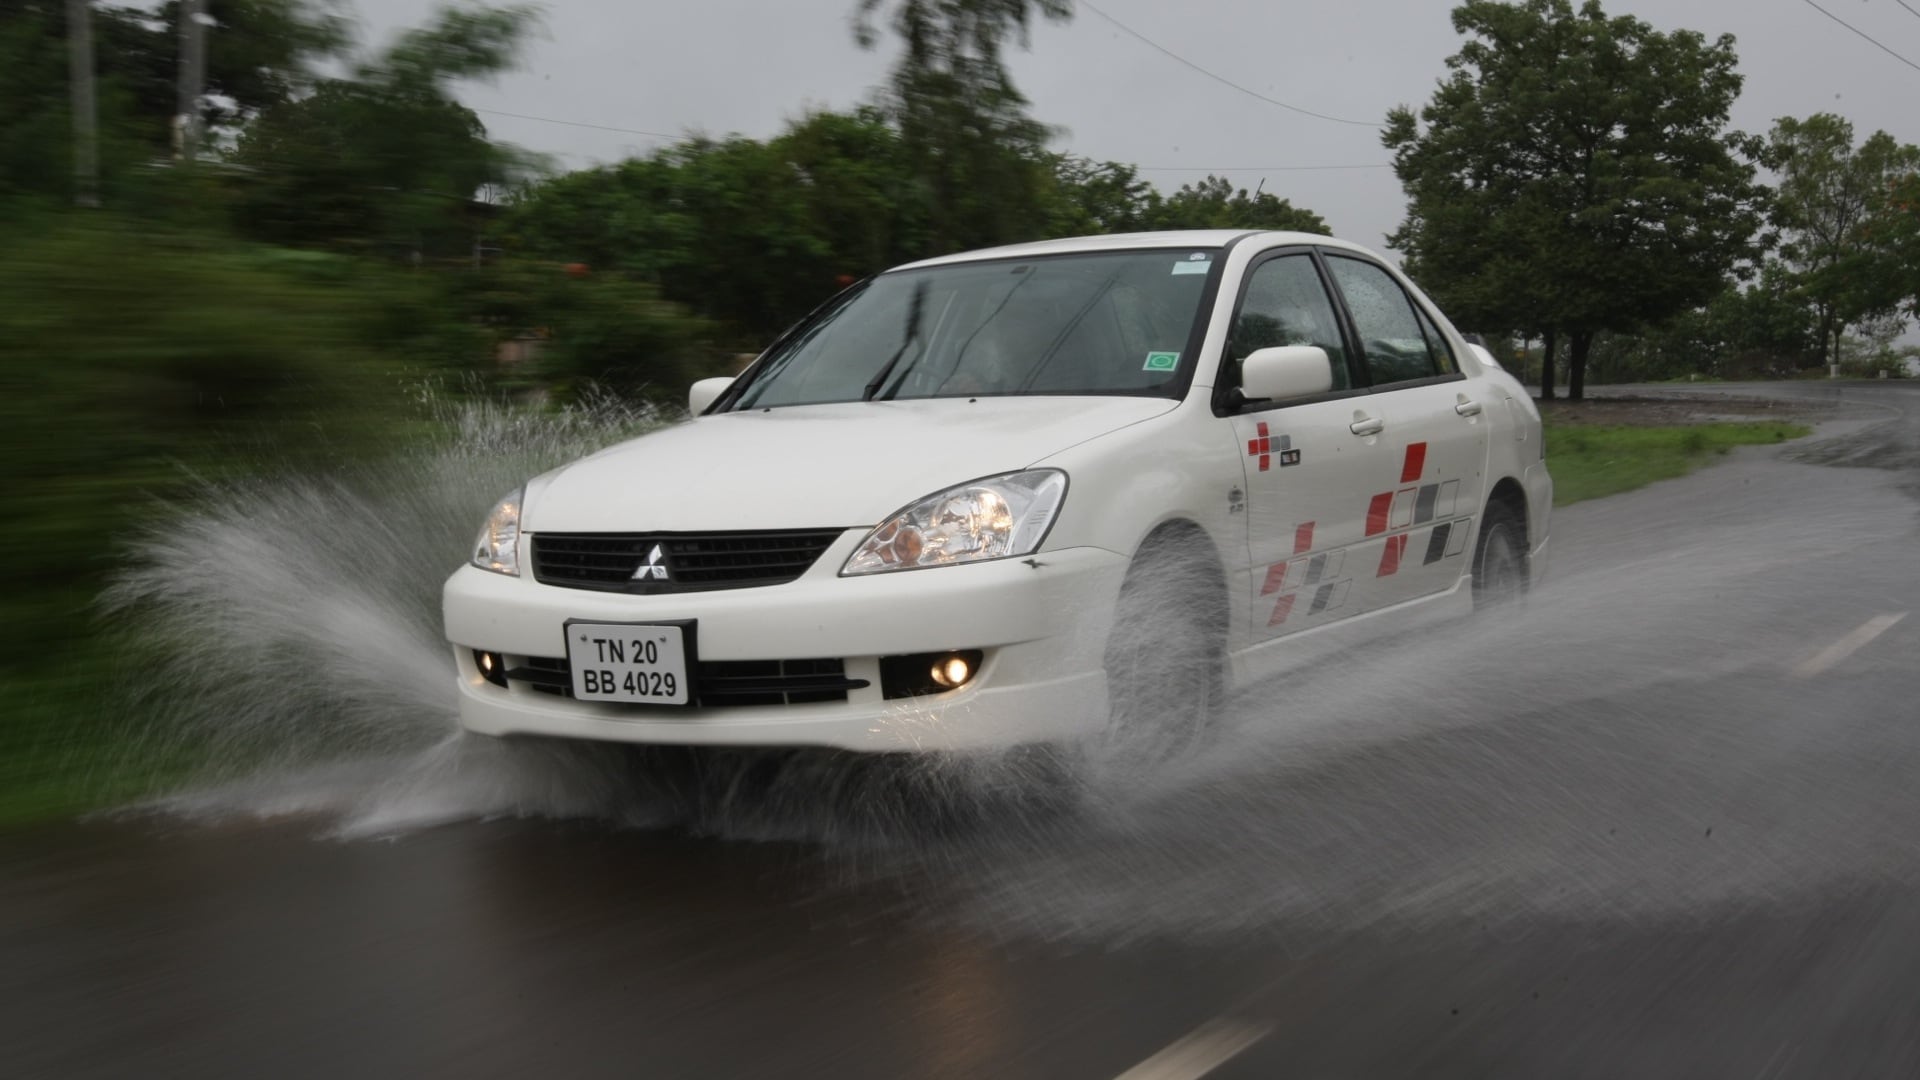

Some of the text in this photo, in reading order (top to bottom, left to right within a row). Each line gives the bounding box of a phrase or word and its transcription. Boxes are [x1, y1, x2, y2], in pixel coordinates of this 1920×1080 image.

[593, 639, 657, 664] TN 20
[583, 669, 676, 697] BB 4029
